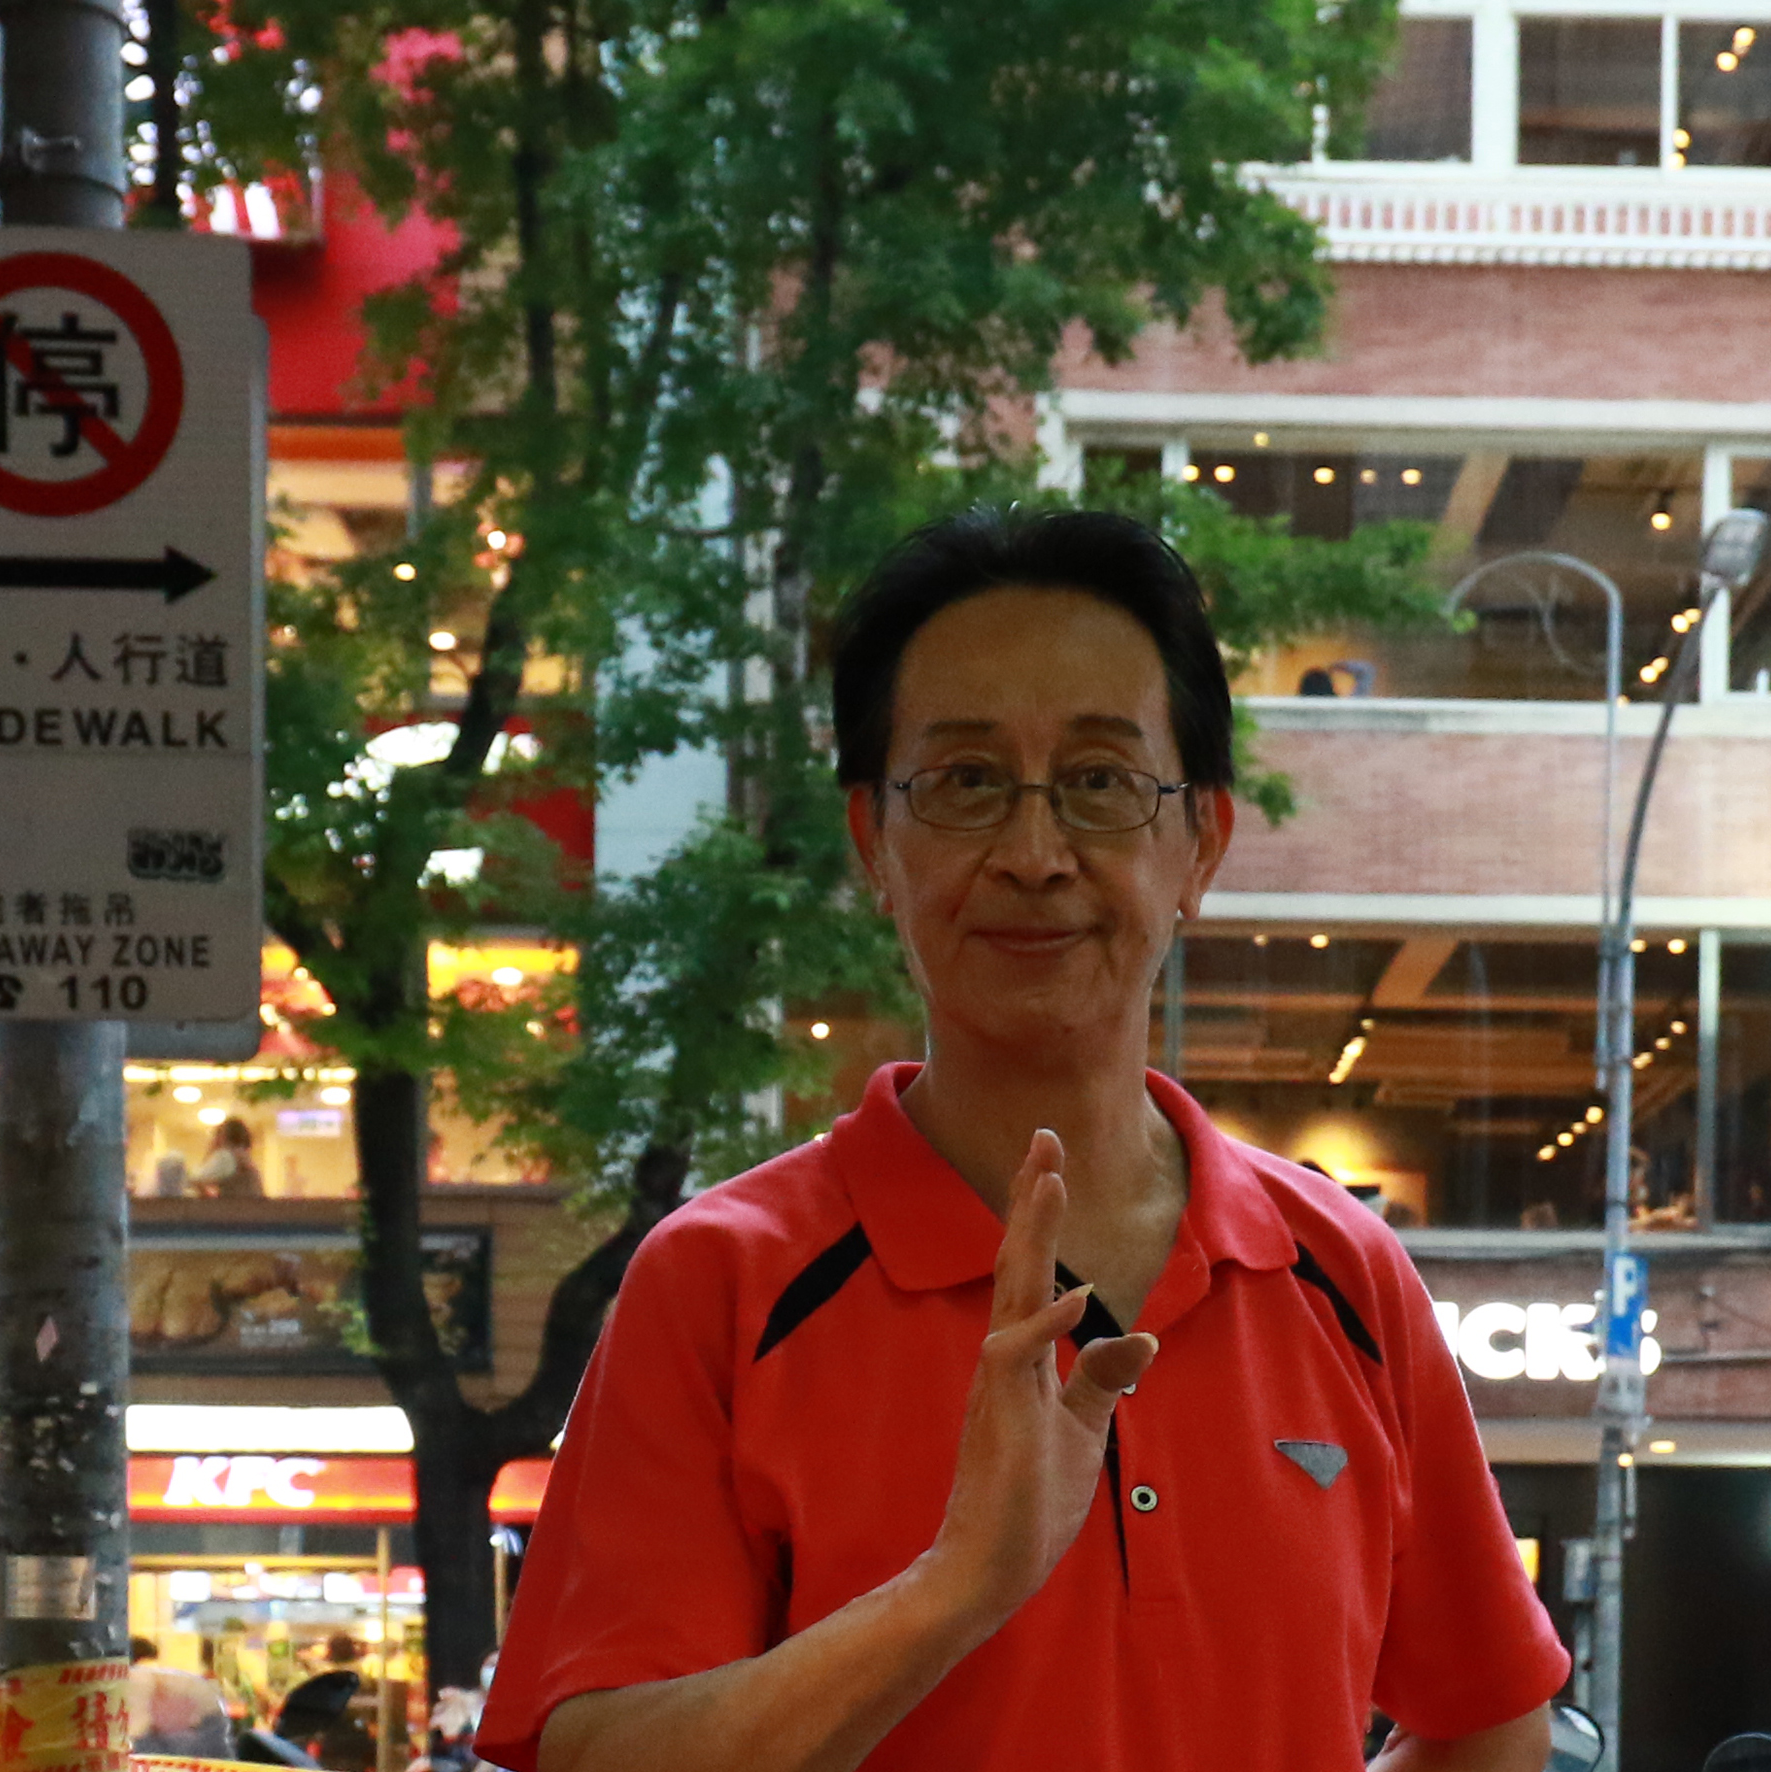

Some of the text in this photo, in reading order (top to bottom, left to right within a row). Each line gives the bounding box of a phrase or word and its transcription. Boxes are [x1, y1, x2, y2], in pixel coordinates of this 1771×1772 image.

[50, 634, 229, 690] 人行道
[111, 934, 212, 968] ZONE
[59, 973, 149, 1011] 110
[162, 1456, 325, 1509] KFC
